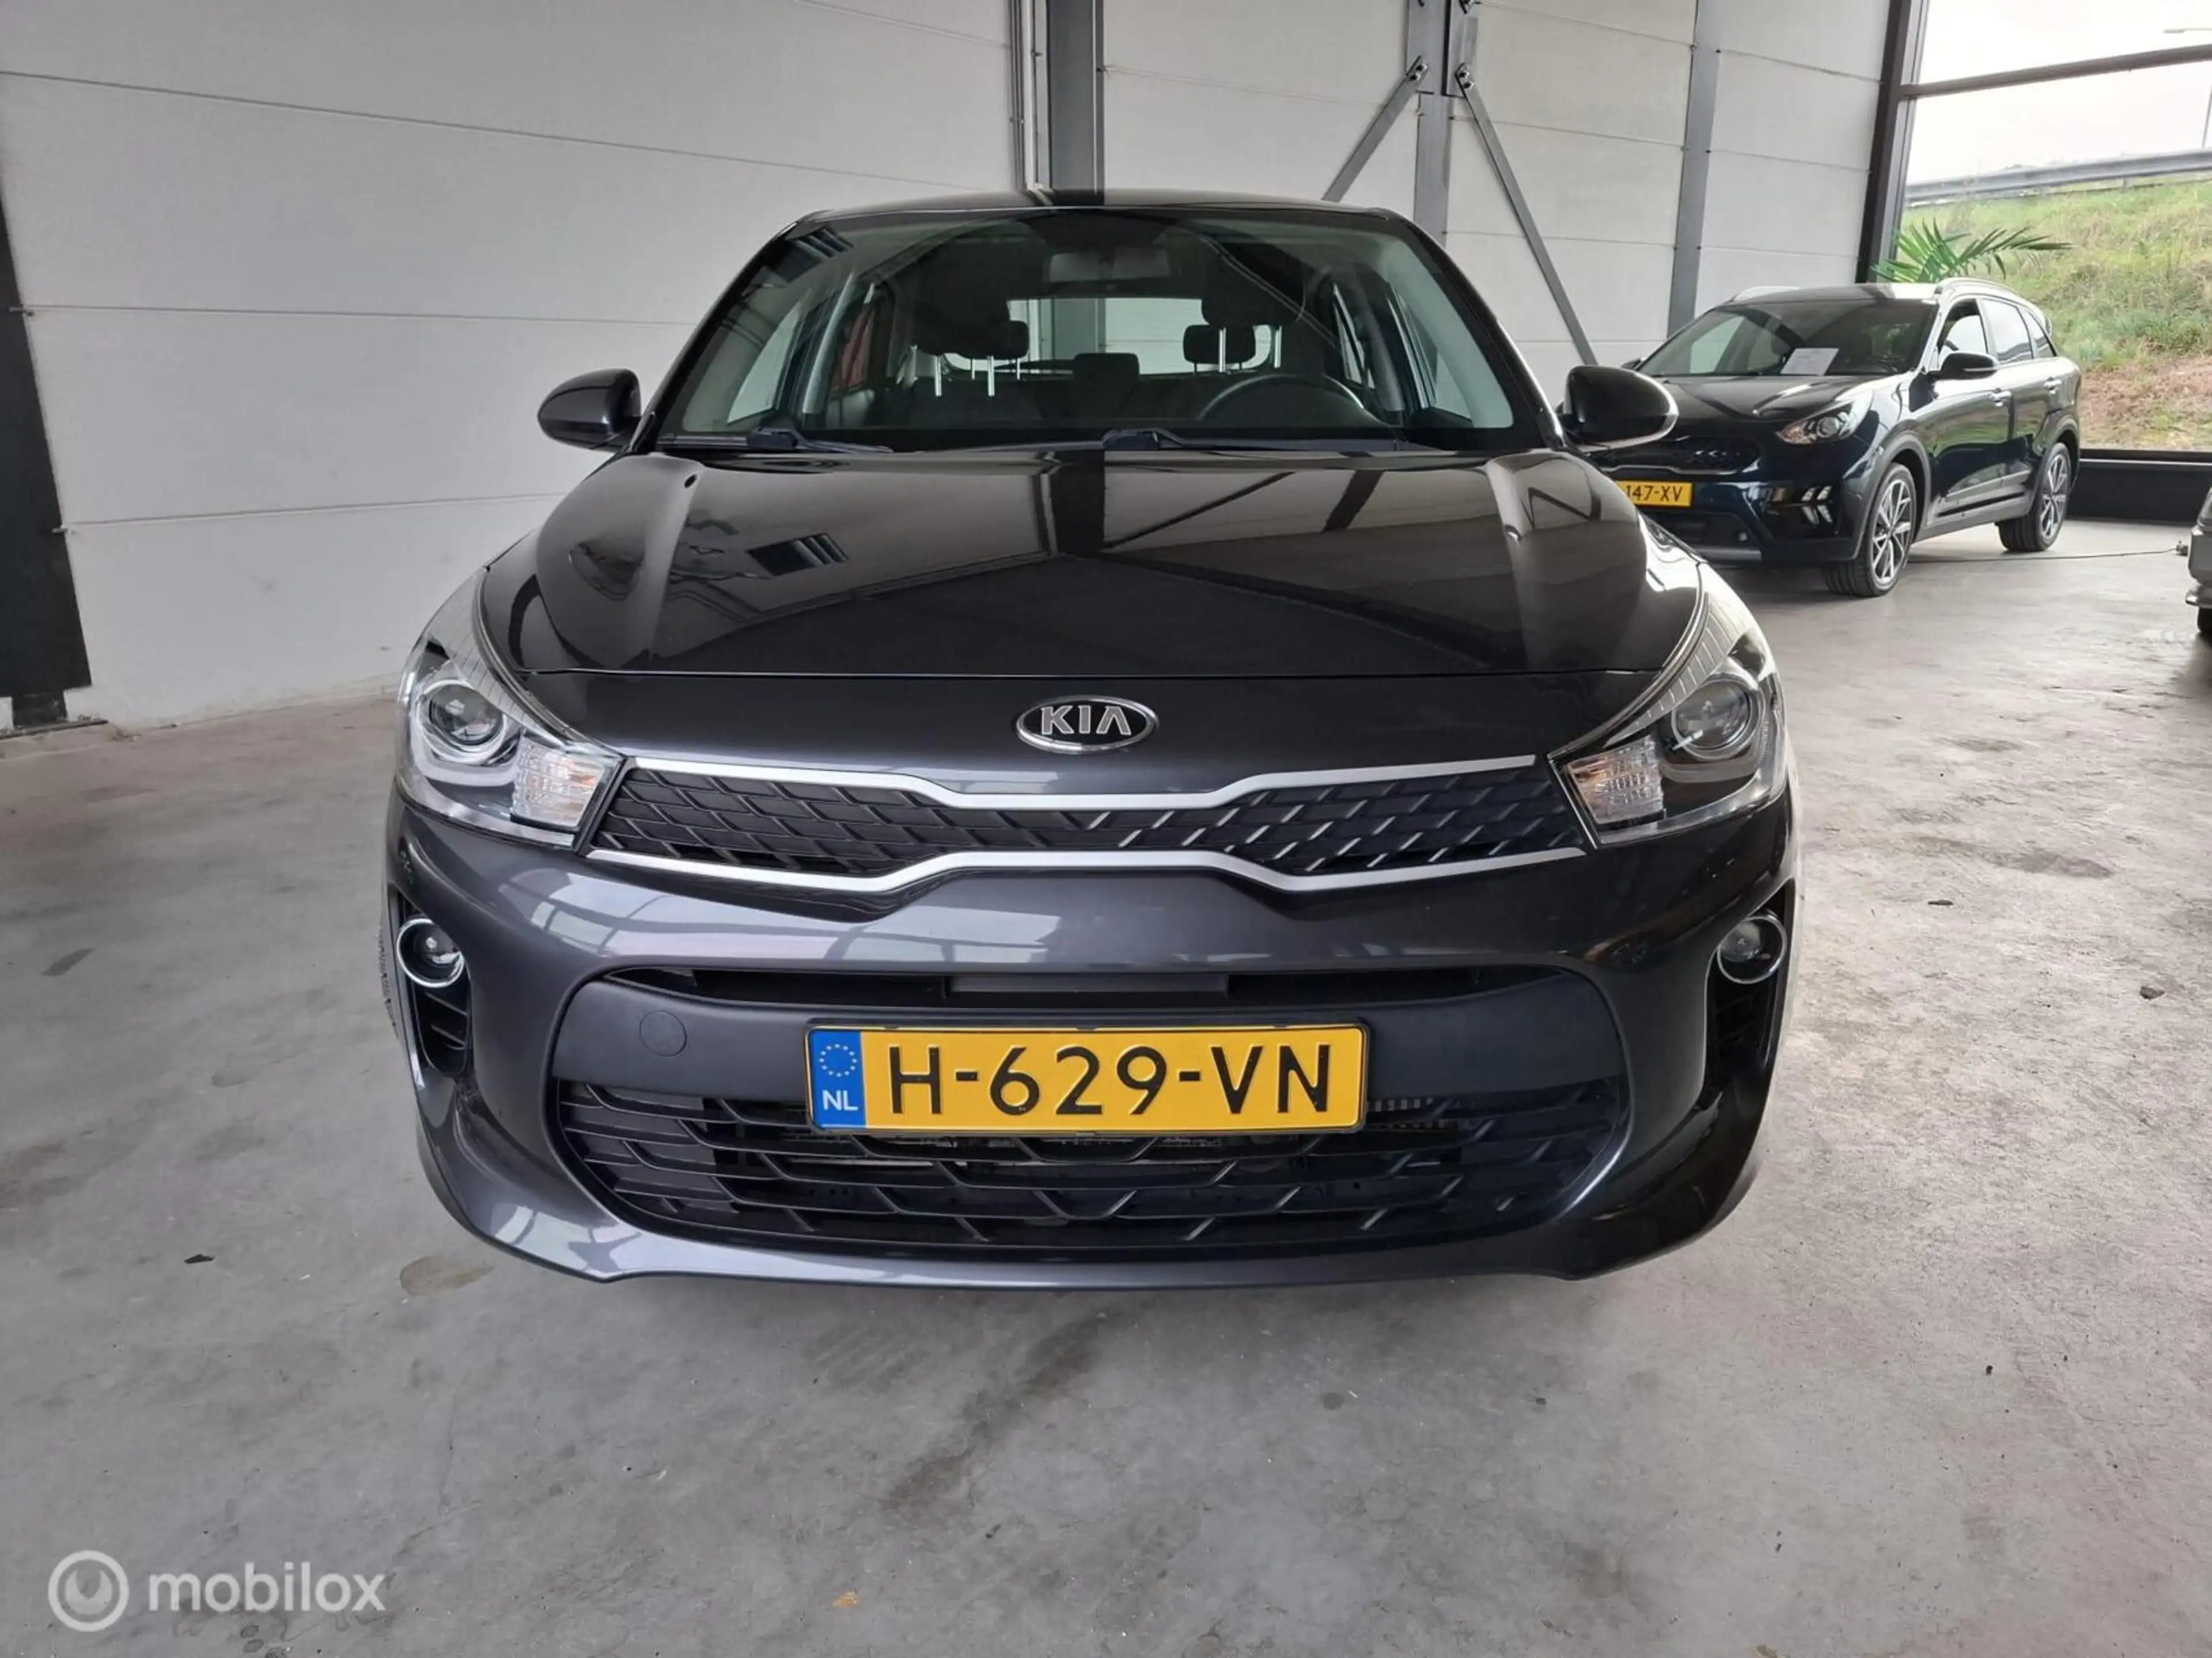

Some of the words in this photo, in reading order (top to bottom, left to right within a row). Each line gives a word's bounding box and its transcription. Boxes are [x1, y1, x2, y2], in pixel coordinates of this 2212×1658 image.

[1041, 705, 1131, 735] KIA
[888, 1044, 1330, 1116] H-629-VN
[822, 1090, 858, 1111] NL
